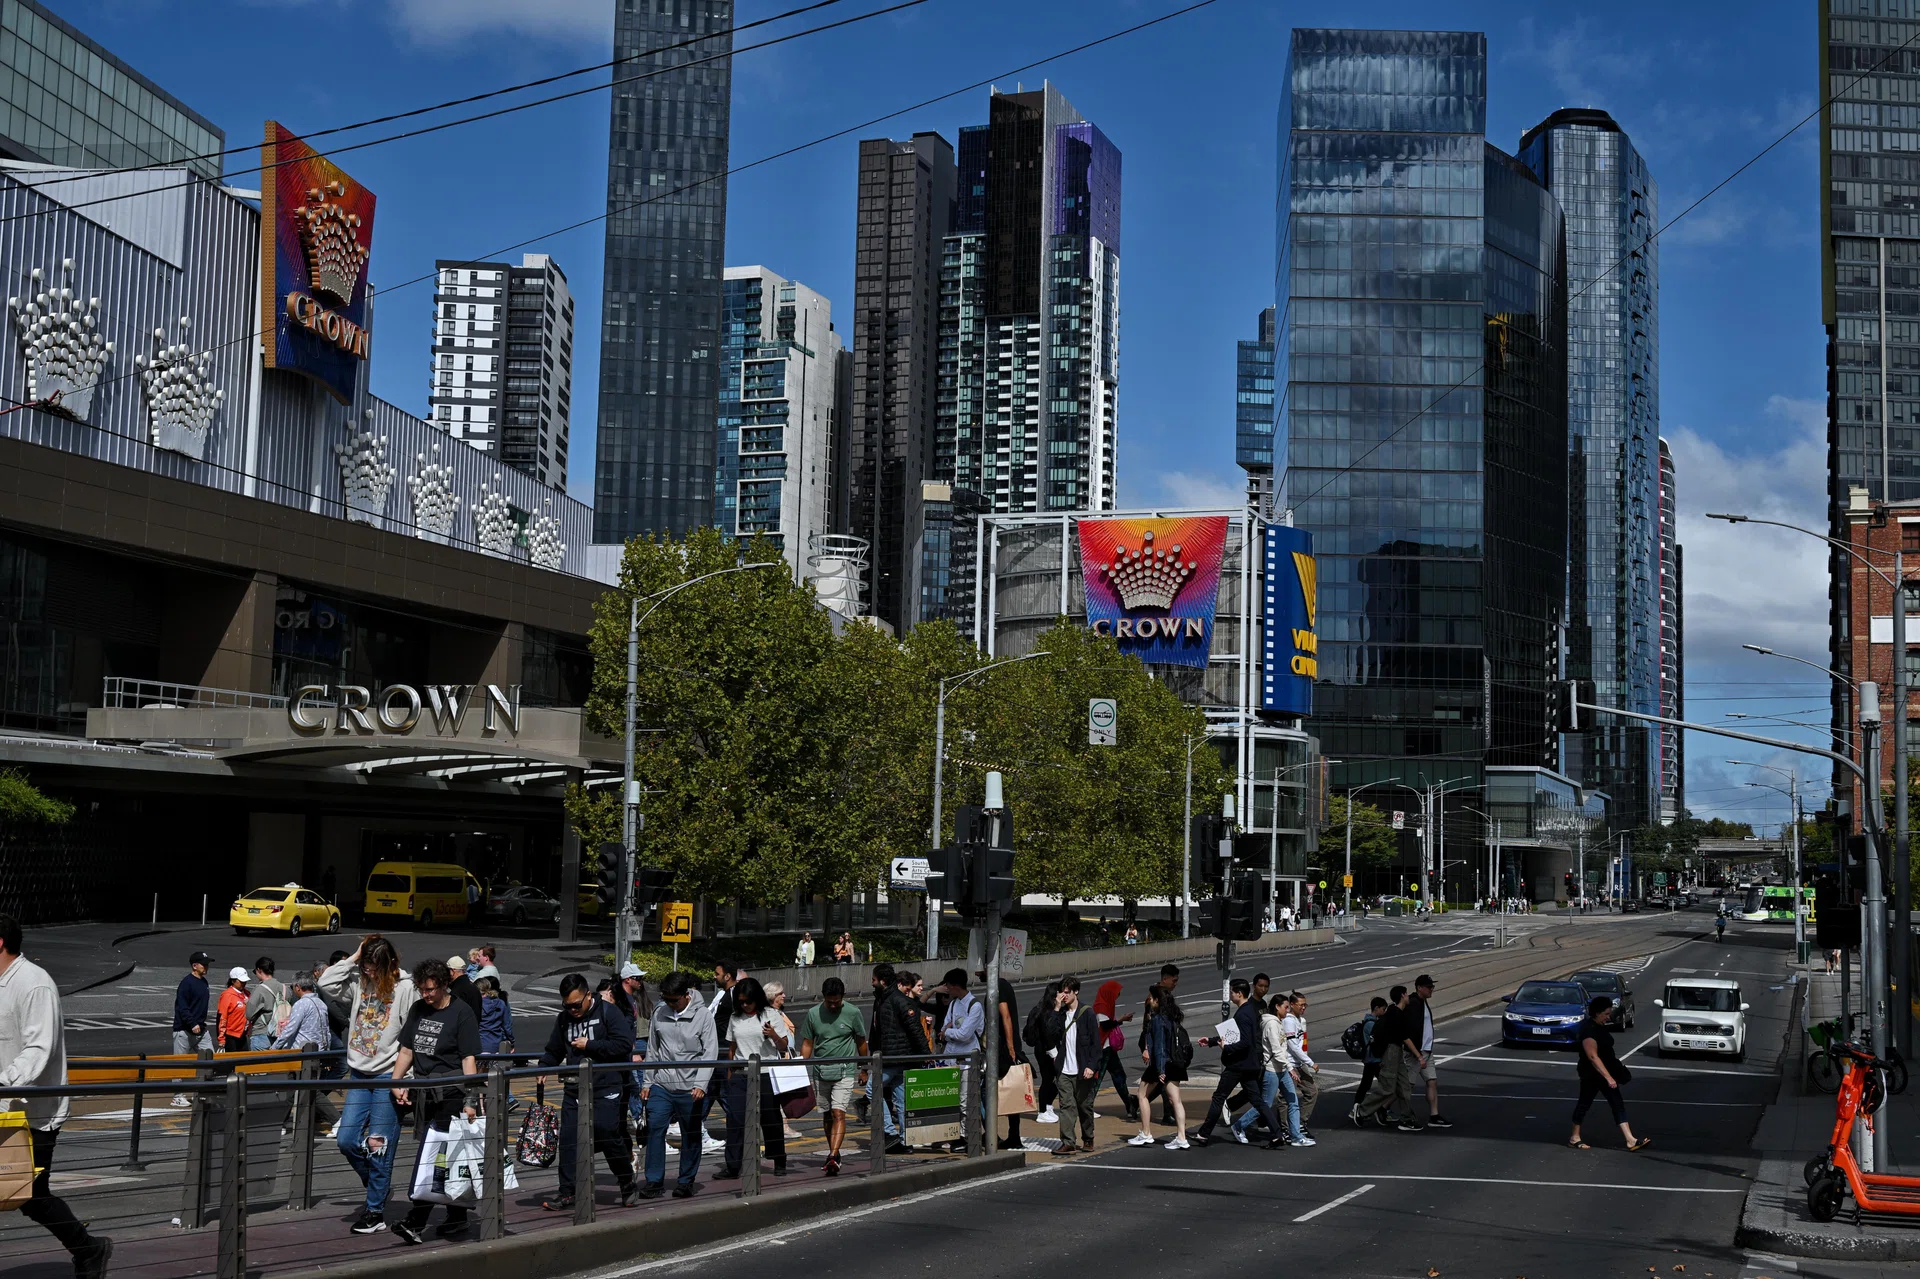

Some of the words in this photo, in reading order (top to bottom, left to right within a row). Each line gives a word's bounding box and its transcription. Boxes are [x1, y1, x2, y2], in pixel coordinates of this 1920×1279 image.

[286, 291, 369, 360] CROWN
[1092, 617, 1204, 638] CROWN
[1291, 628, 1317, 655] VILL
[287, 684, 523, 738] CROWN
[910, 1088, 924, 1099] Casino
[927, 1087, 946, 1097] Exhibition
[946, 1086, 959, 1096] Centre
